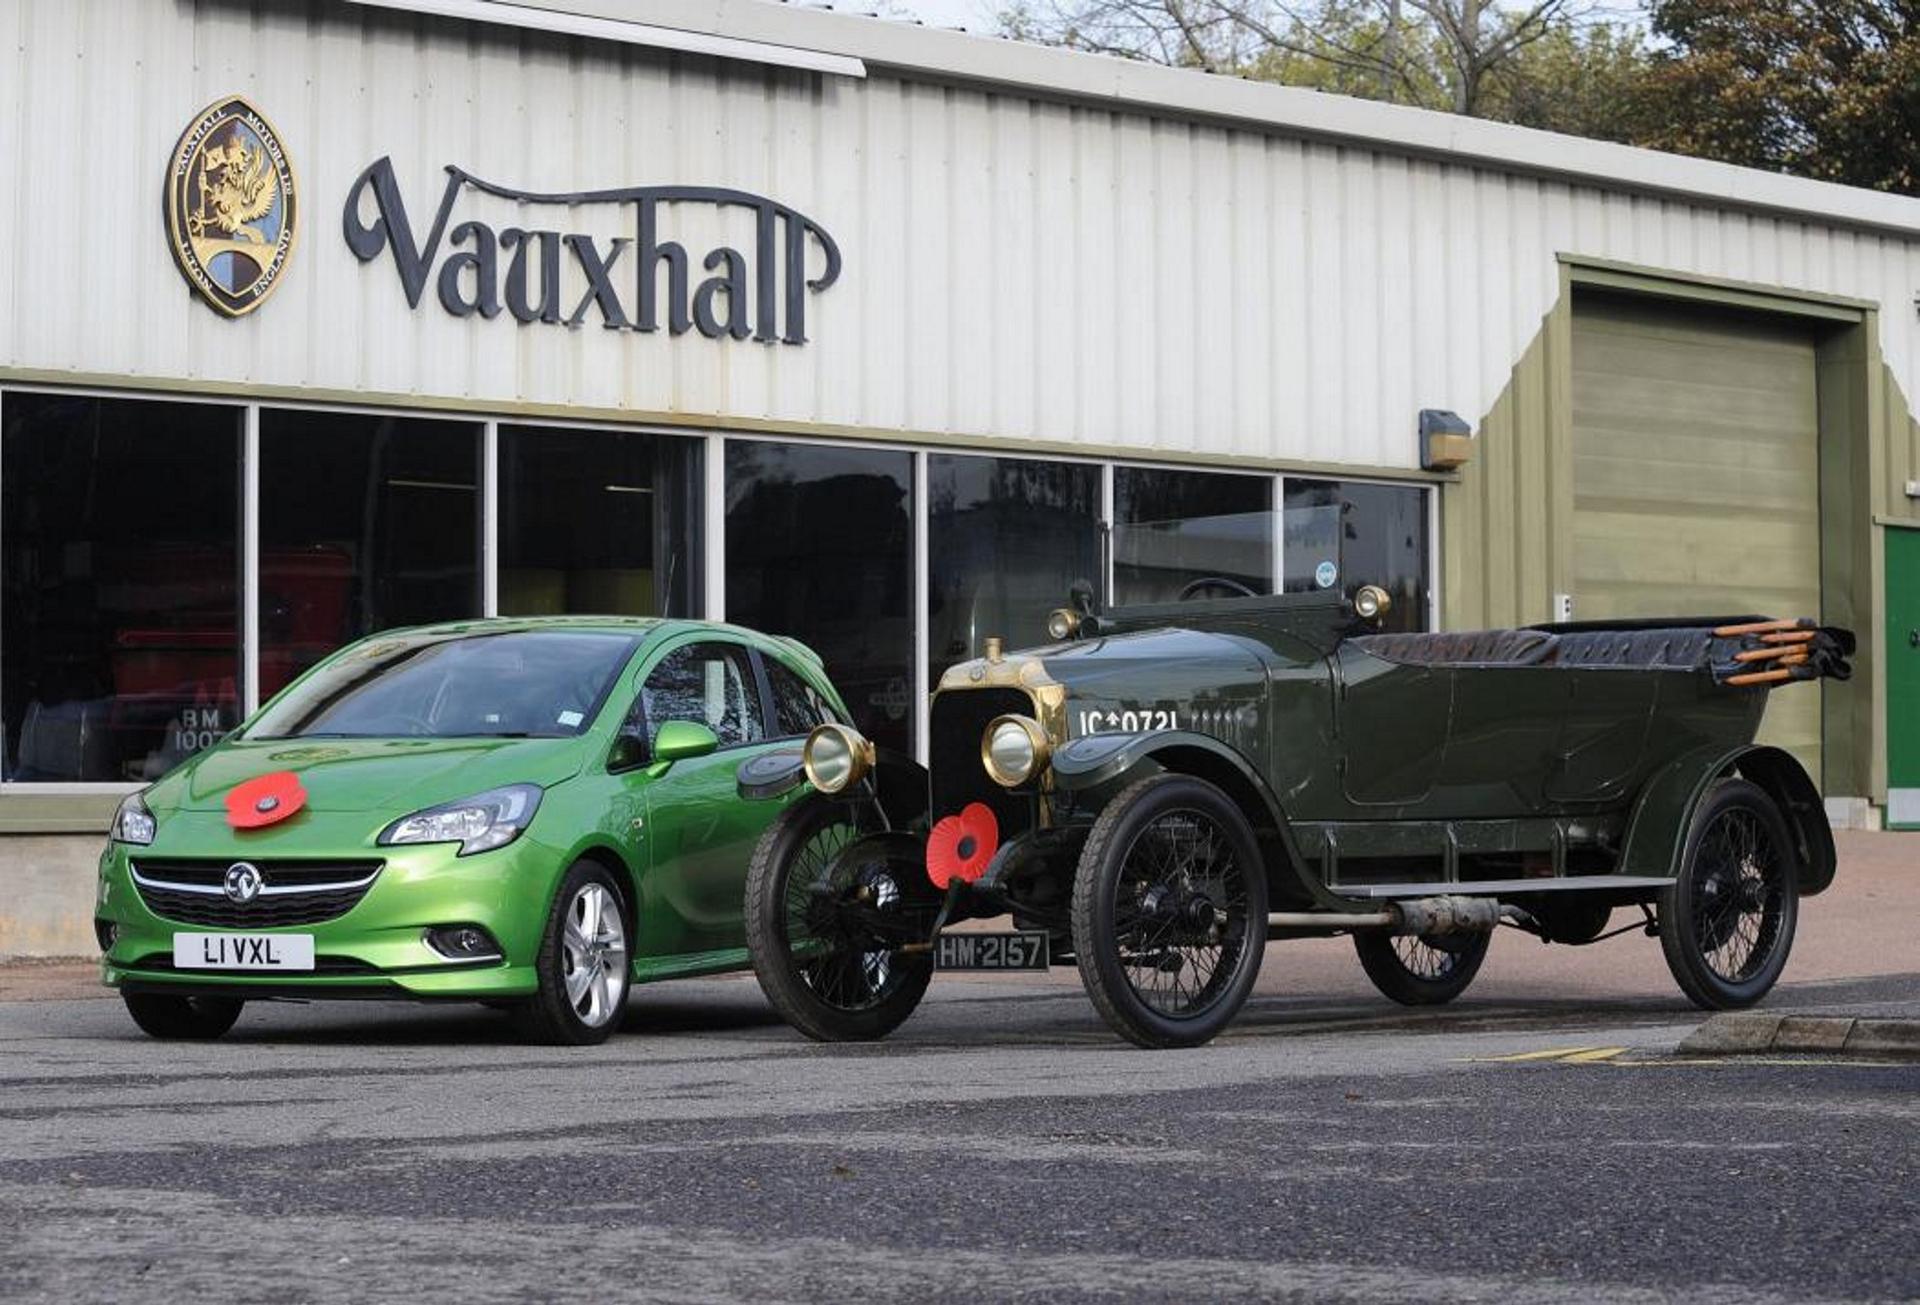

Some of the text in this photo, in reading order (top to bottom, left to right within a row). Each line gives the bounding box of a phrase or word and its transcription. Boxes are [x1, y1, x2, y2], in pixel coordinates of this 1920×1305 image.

[177, 109, 227, 176] VAUXHALL
[246, 111, 286, 168] MOTORS
[253, 228, 292, 297] ENGLAND
[343, 156, 842, 345] Vauxhall
[233, 937, 281, 964] VXL
